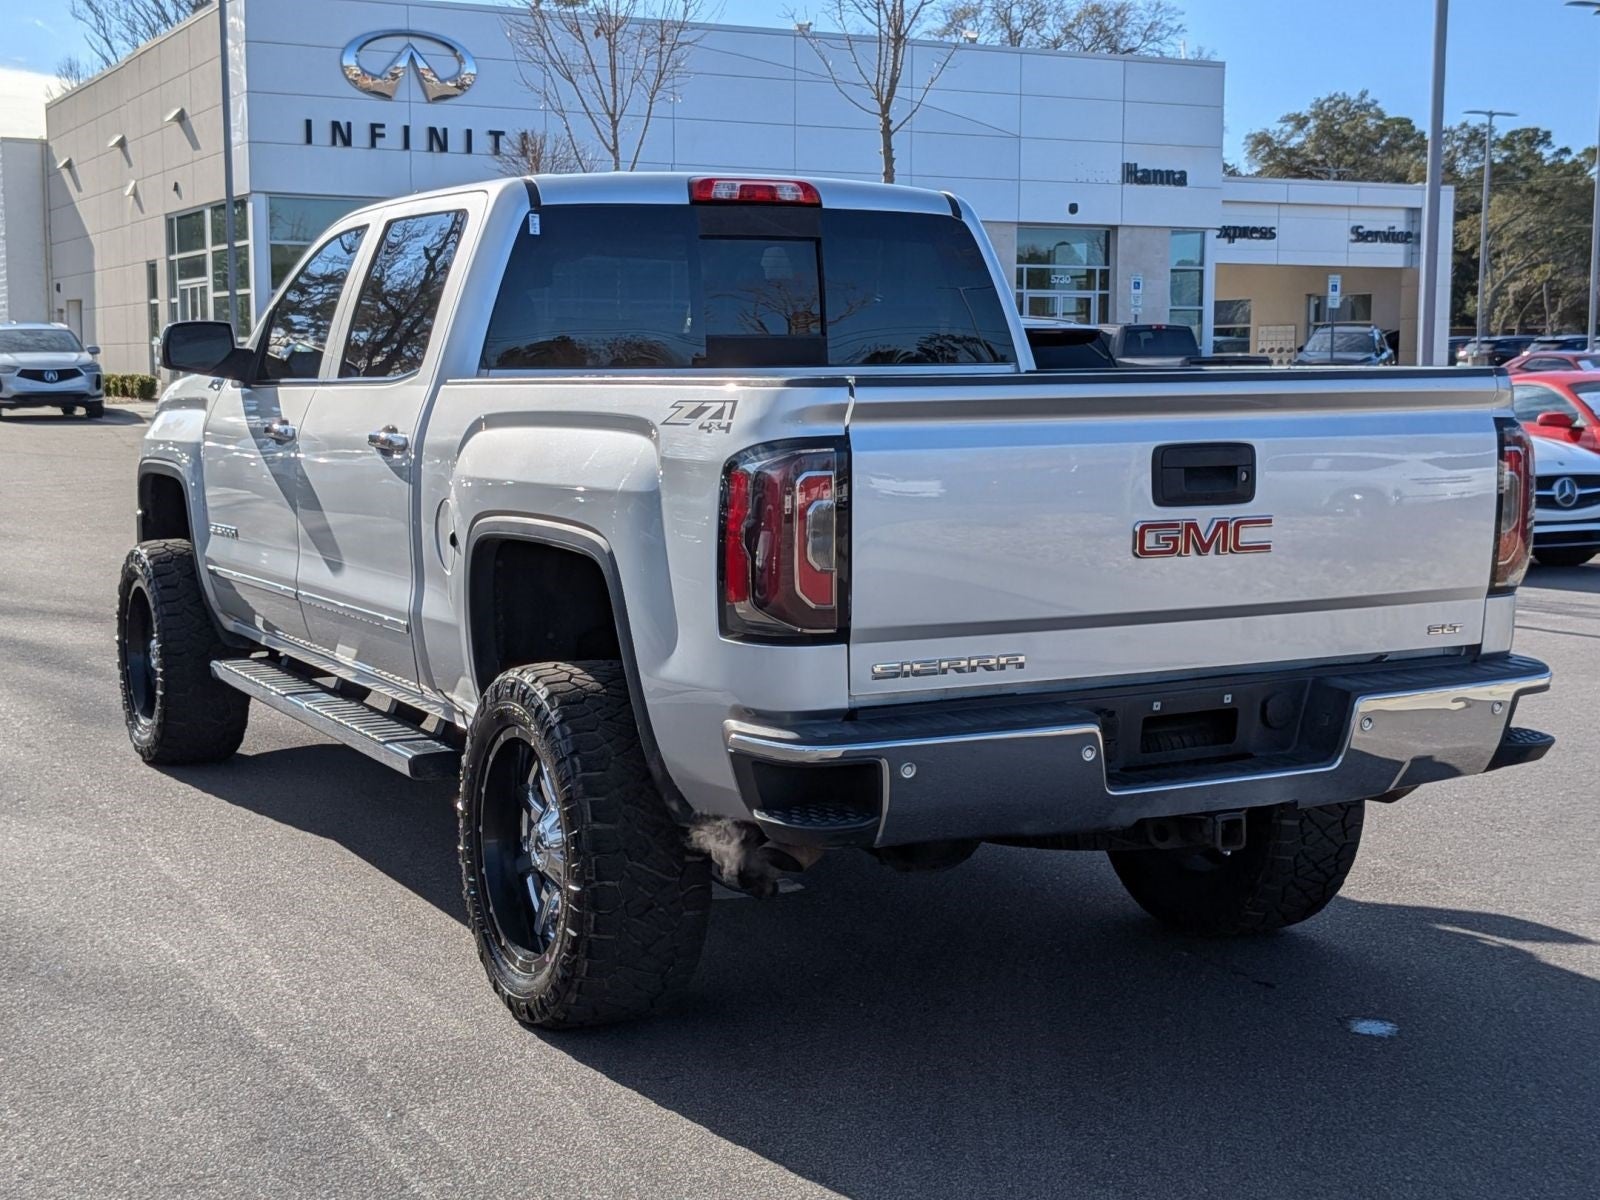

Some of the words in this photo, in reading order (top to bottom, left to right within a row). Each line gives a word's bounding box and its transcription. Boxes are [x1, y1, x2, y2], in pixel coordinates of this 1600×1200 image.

[305, 118, 528, 158] INFINITI
[1349, 225, 1414, 245] Service
[660, 399, 739, 426] Z71
[1132, 515, 1273, 559] GMC
[1427, 622, 1464, 635] SLT
[871, 653, 1026, 681] SIERRA
